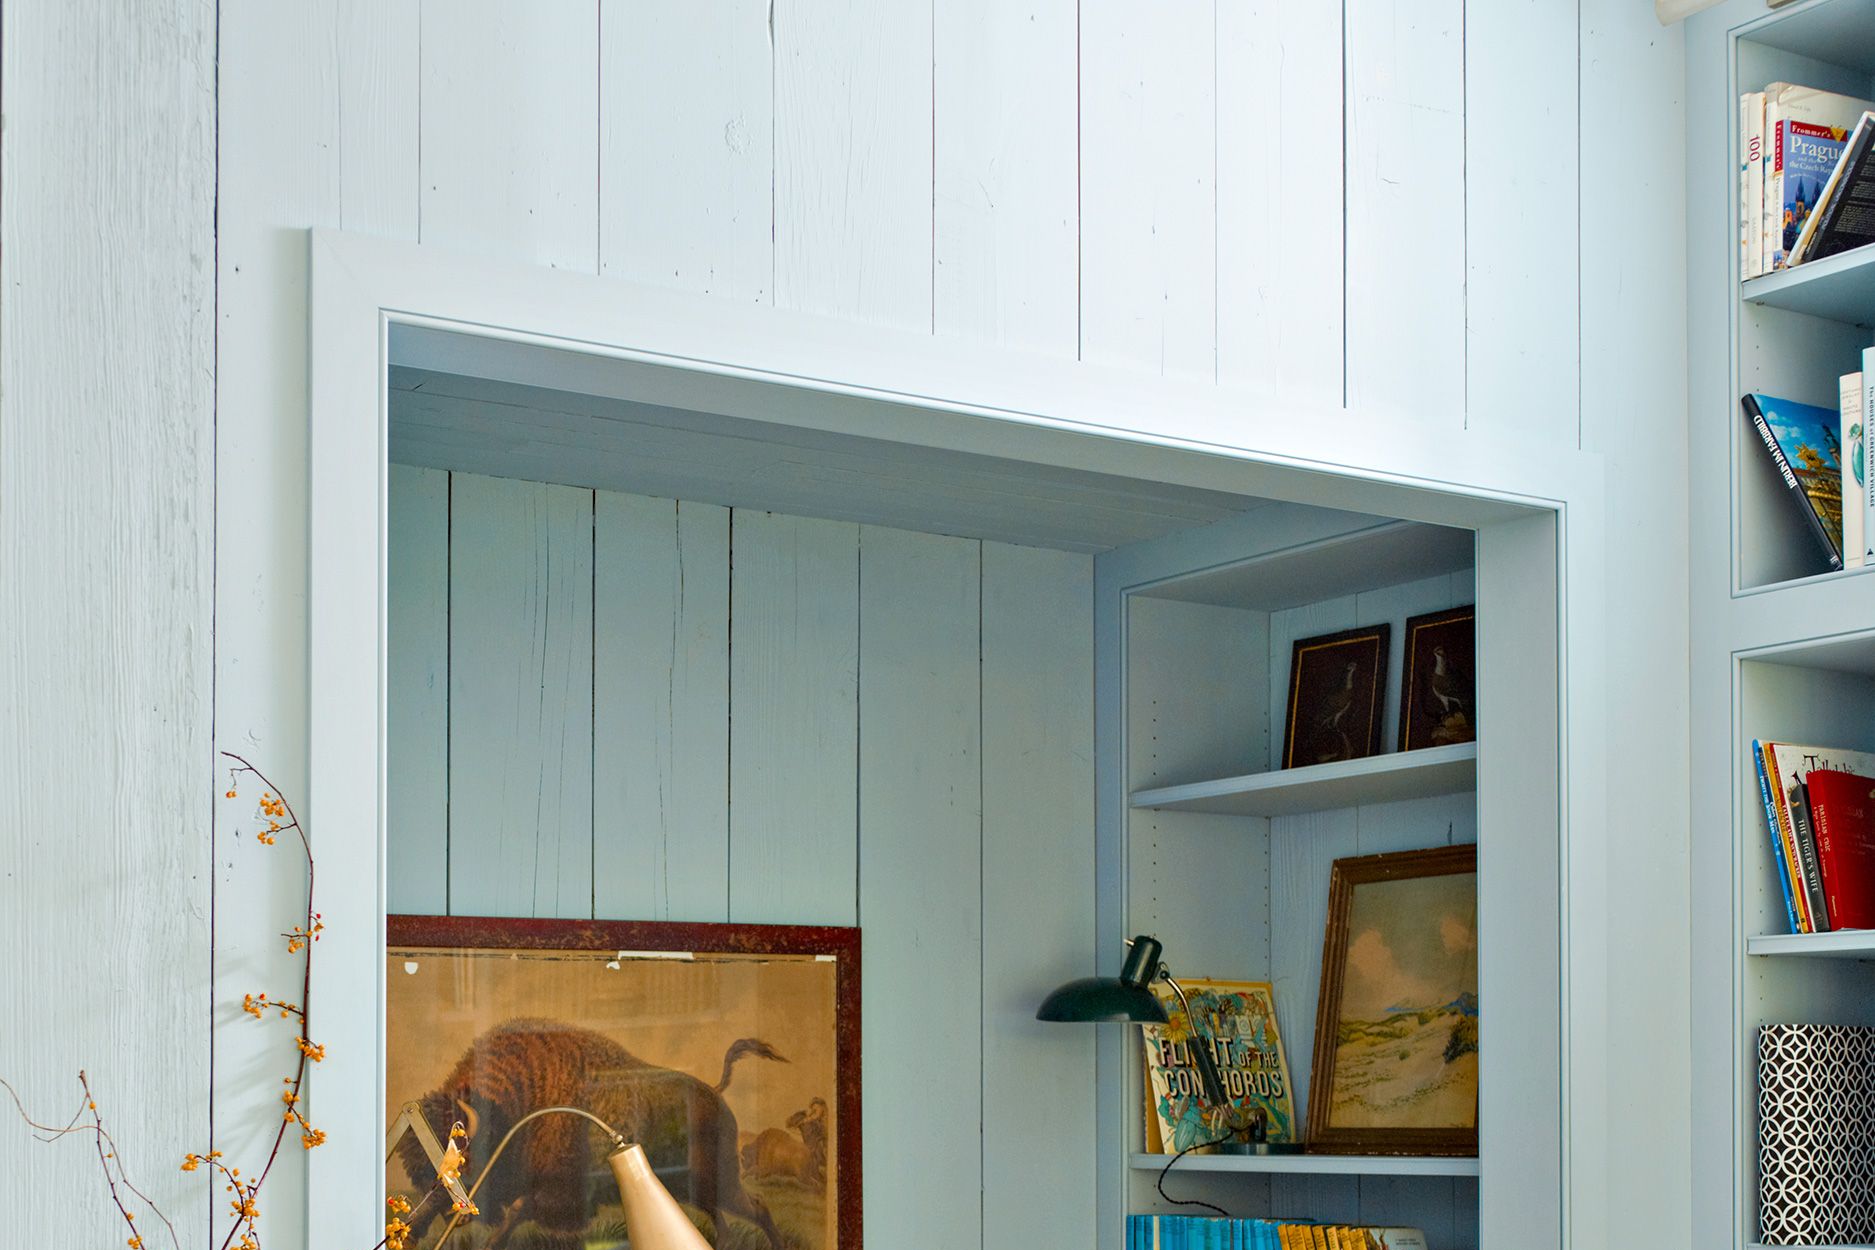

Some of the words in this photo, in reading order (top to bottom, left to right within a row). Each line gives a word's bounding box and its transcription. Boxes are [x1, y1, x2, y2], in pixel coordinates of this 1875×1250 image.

[1791, 125, 1830, 138] Frommer's
[1750, 134, 1761, 162] 100
[1817, 804, 1829, 835] PARISIAN
[1823, 836, 1831, 862] CHIC
[1798, 820, 1806, 836] THE
[1802, 838, 1813, 870] TIGER'S
[1808, 872, 1818, 893] WIFE
[1158, 1037, 1233, 1066] FLIHT
[1239, 1053, 1252, 1066] OF
[1255, 1051, 1279, 1067] THE
[1164, 1070, 1284, 1097] CONHORDS
